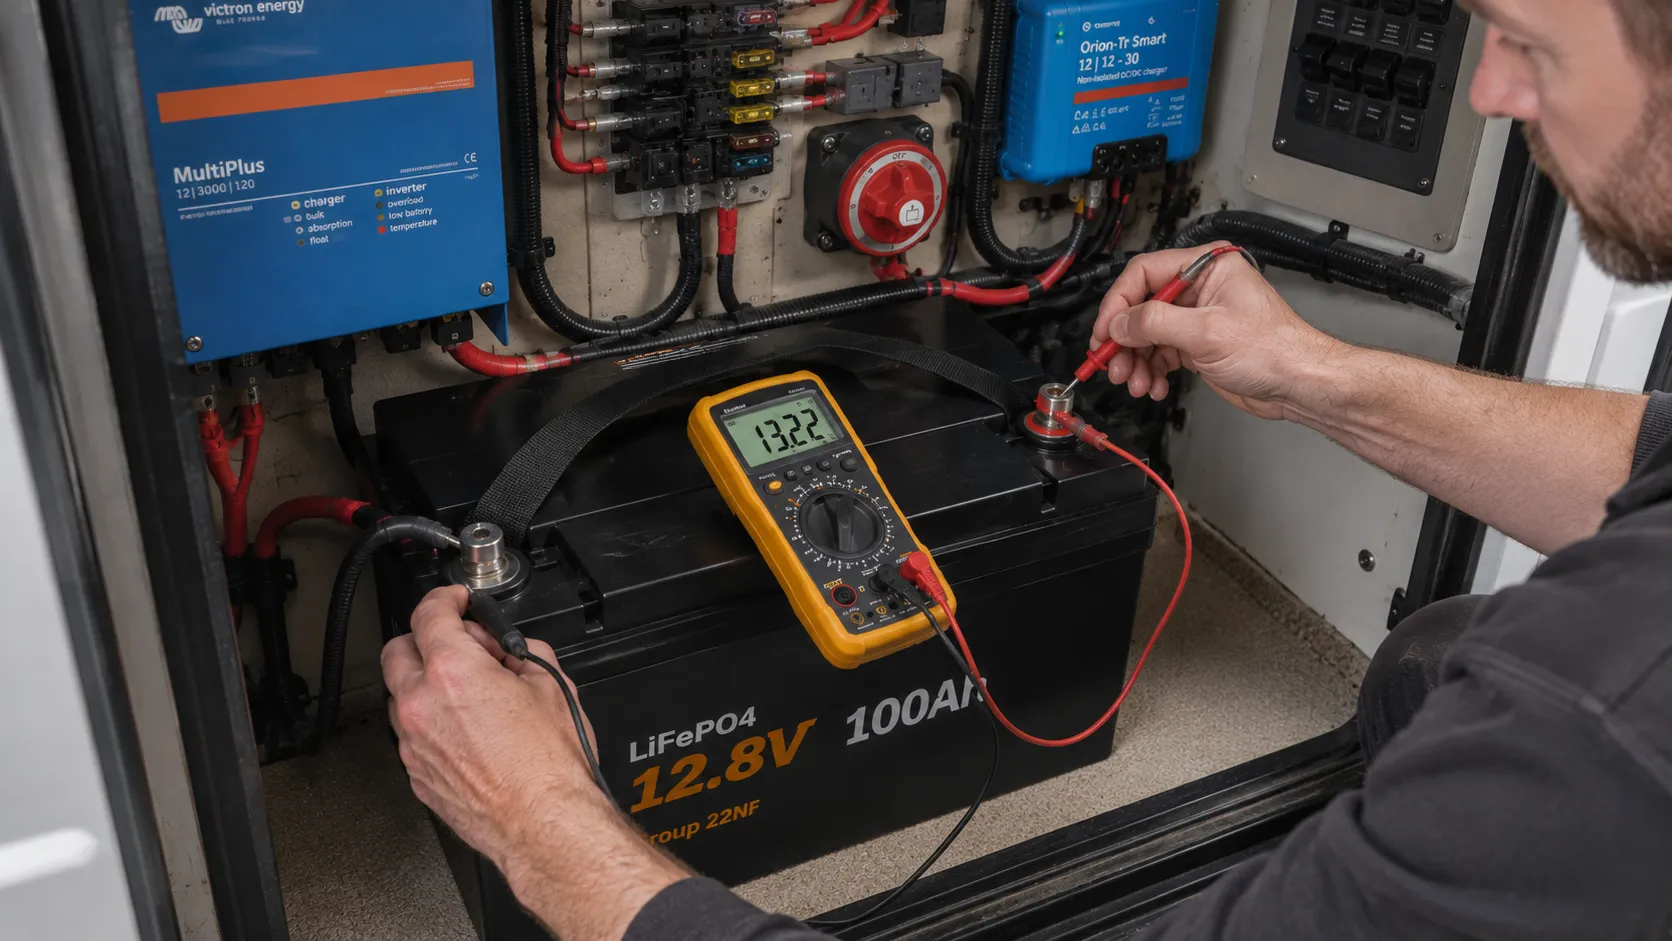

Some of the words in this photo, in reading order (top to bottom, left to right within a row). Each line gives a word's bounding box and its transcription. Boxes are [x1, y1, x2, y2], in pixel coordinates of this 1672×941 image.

[204, 3, 253, 17] victron
[257, 0, 304, 14] energy
[1080, 36, 1130, 54] Orion-Tr
[1132, 32, 1167, 48] Smart
[1079, 58, 1093, 71] 12
[1101, 54, 1115, 68] 12
[1124, 52, 1139, 65] 30
[173, 159, 265, 184] MultiPlus
[386, 183, 427, 196] inverter
[304, 195, 346, 208] charger
[308, 219, 353, 233] absorption
[755, 408, 825, 454] 13.22
[846, 674, 987, 746] 100Ah
[629, 706, 756, 763] LiFePO4
[630, 717, 817, 814] 12.8V
[643, 821, 701, 846] roup
[705, 799, 761, 830] 22NF
